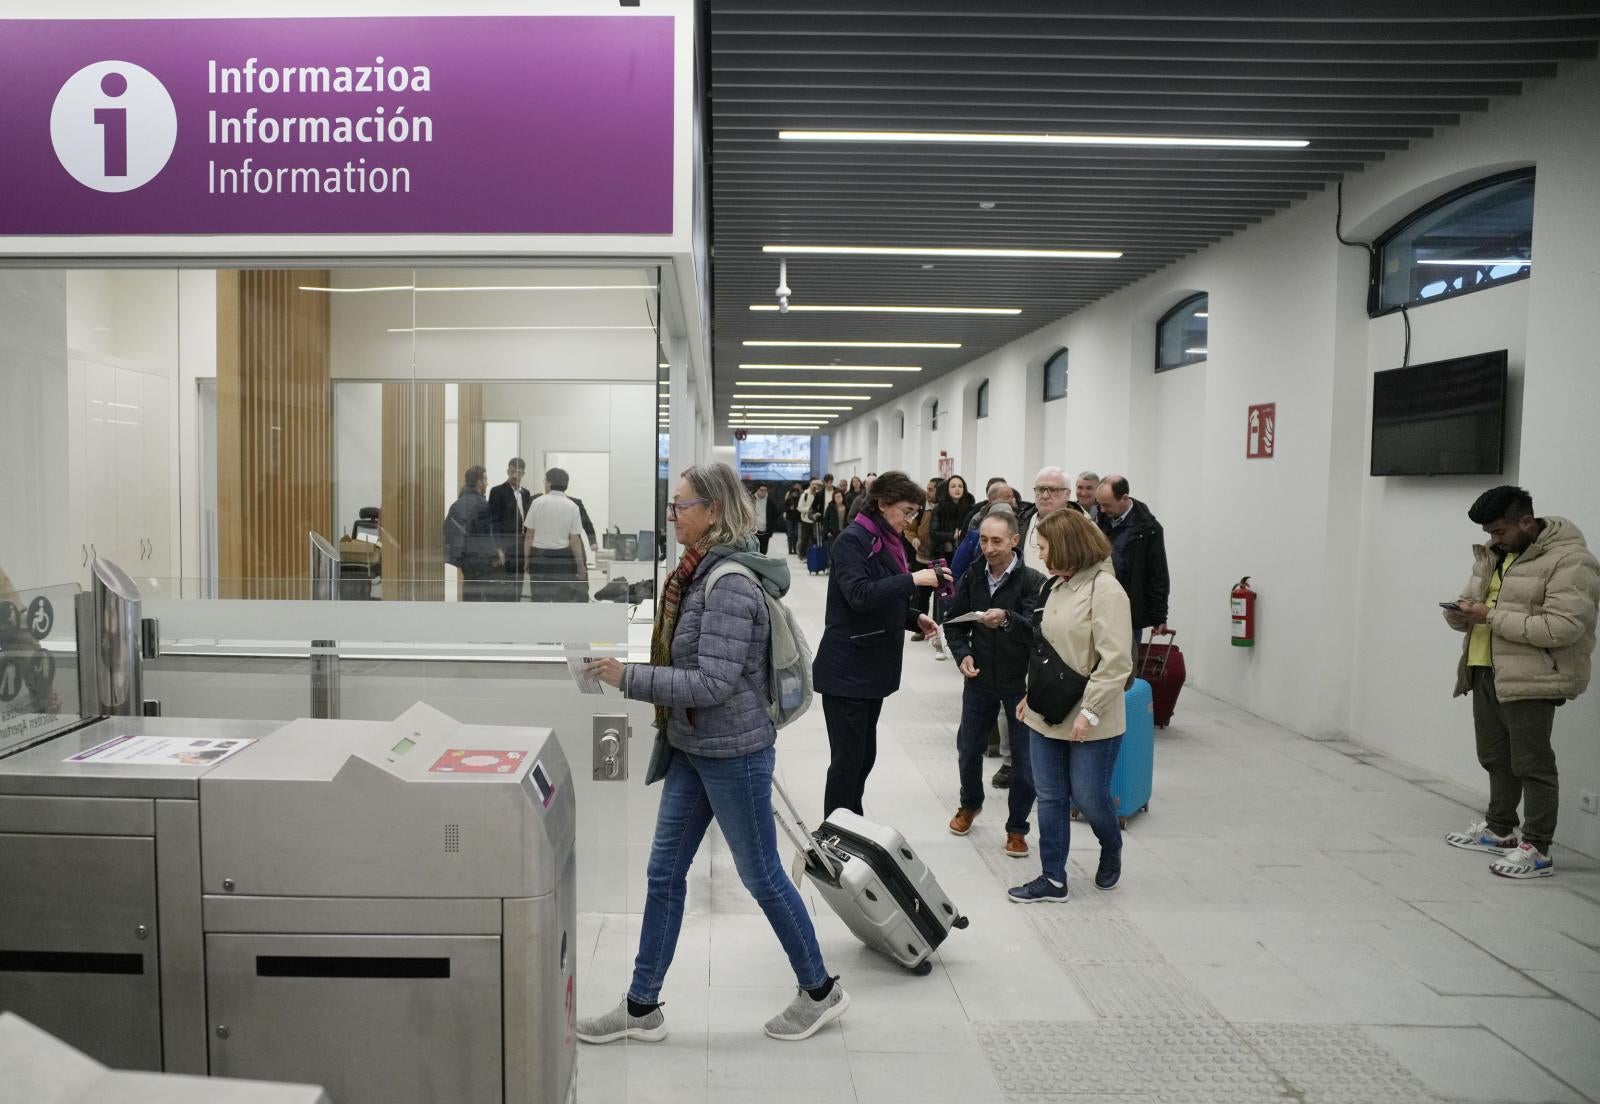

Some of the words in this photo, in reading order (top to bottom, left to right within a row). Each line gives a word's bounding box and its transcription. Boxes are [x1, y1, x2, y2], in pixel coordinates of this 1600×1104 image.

[208, 56, 431, 94] Informazioa
[208, 106, 433, 144] Información
[209, 158, 411, 194] Information
